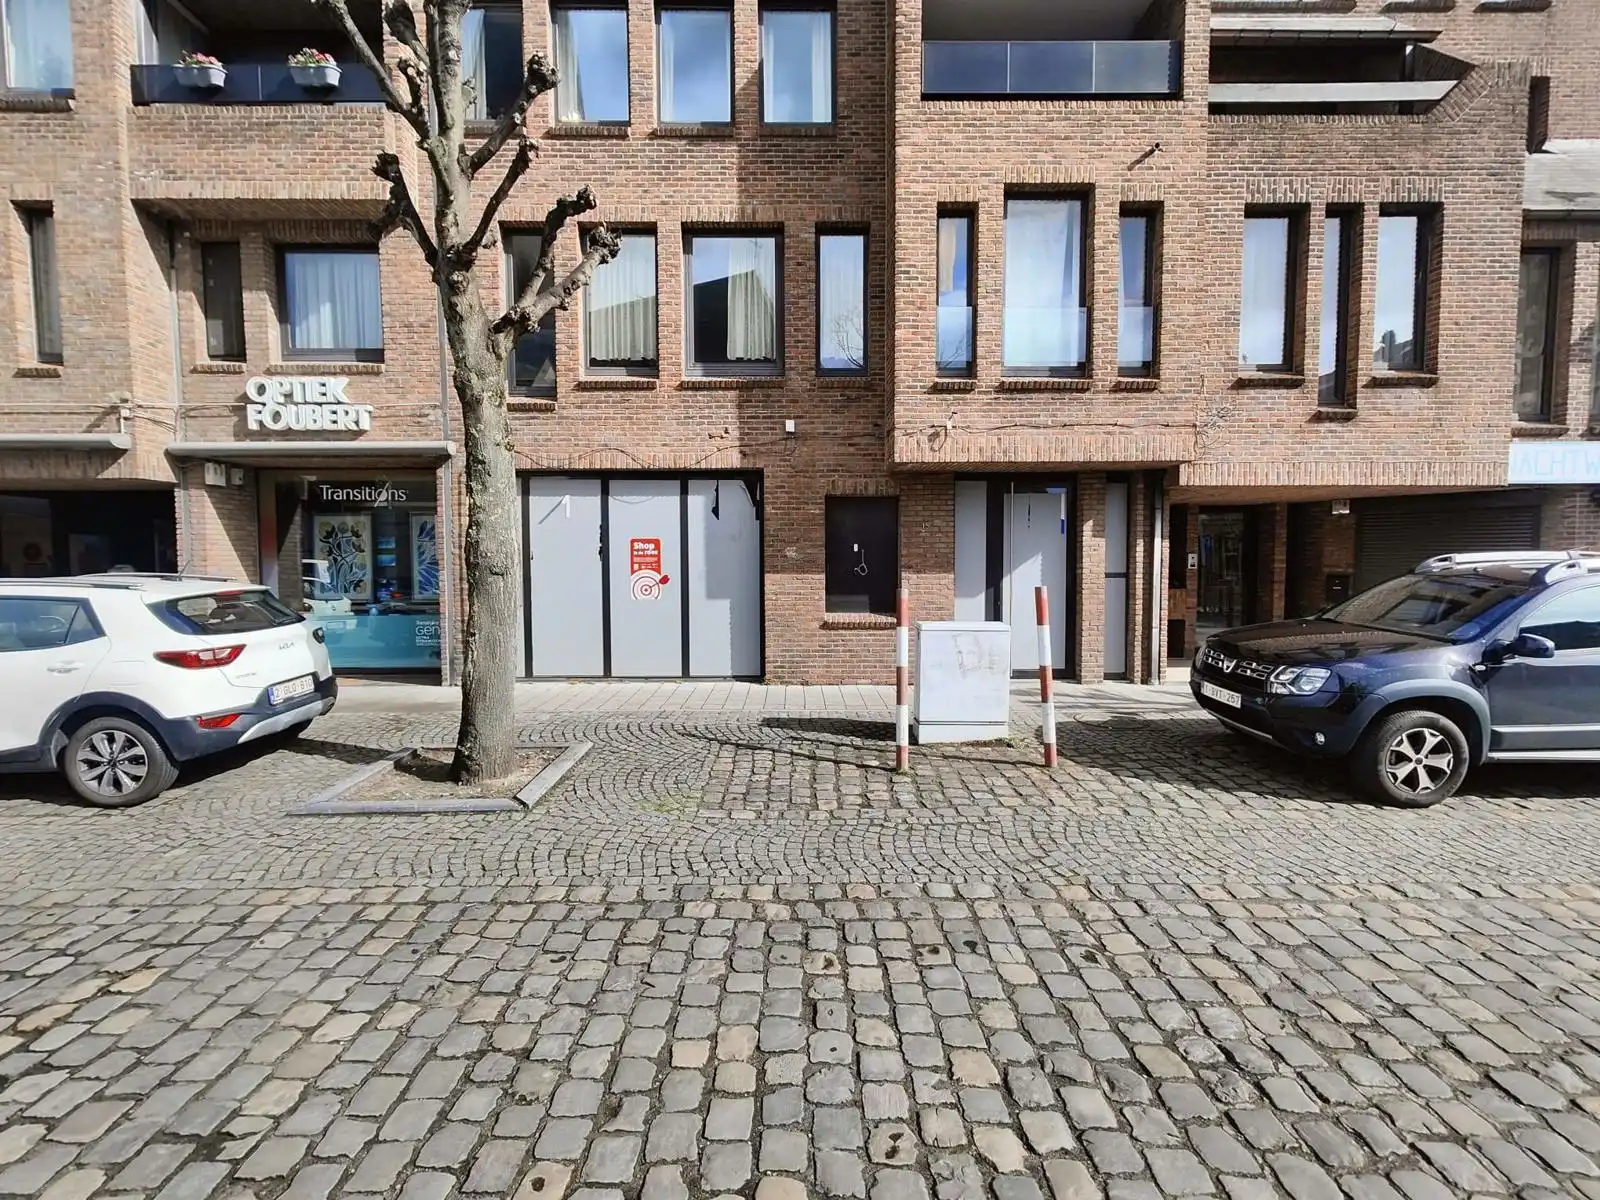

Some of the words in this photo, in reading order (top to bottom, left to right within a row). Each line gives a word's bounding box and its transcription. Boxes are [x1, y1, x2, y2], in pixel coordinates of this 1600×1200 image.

[245, 376, 350, 403] OPTIEK
[246, 402, 373, 431] FOUBERT
[319, 482, 407, 507] Transitions
[633, 541, 655, 551] Shop
